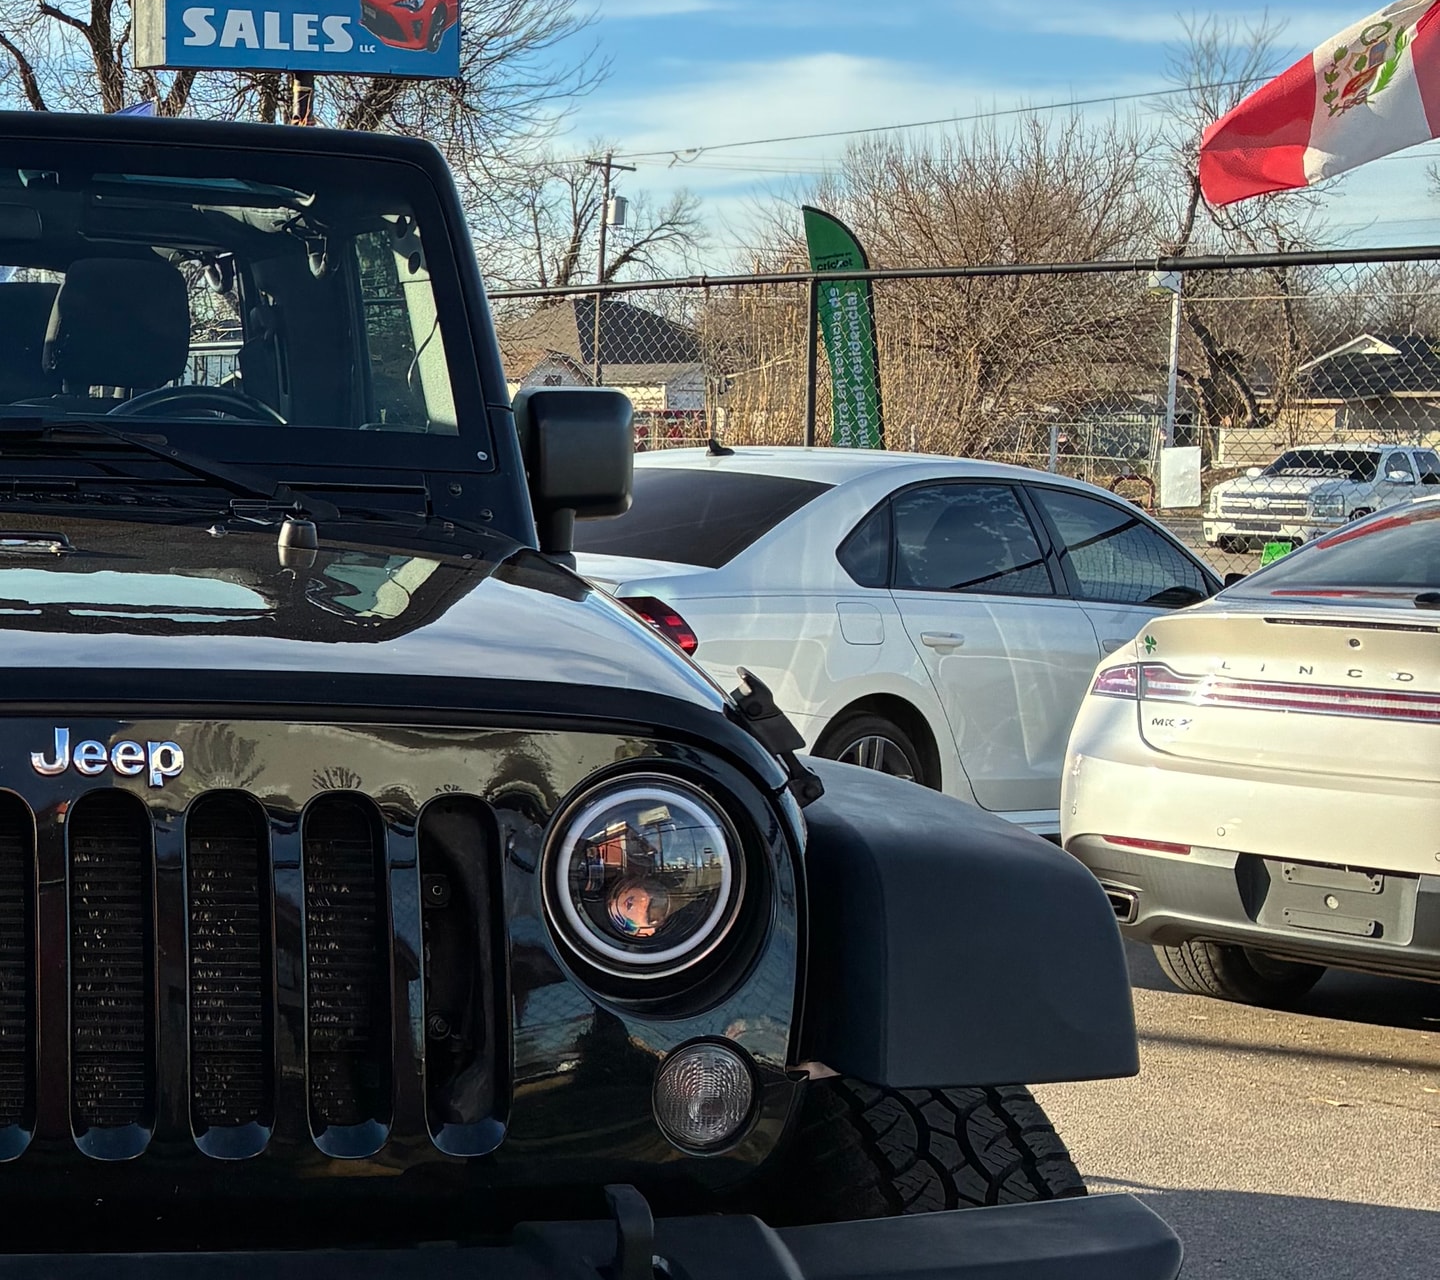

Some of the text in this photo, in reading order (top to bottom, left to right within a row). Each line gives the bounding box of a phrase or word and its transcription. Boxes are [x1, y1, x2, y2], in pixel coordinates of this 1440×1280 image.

[182, 7, 376, 54] SALES LLC
[816, 257, 853, 271] cricket
[828, 287, 840, 308] de
[846, 292, 864, 381] residencial
[30, 727, 185, 788] Jeep
